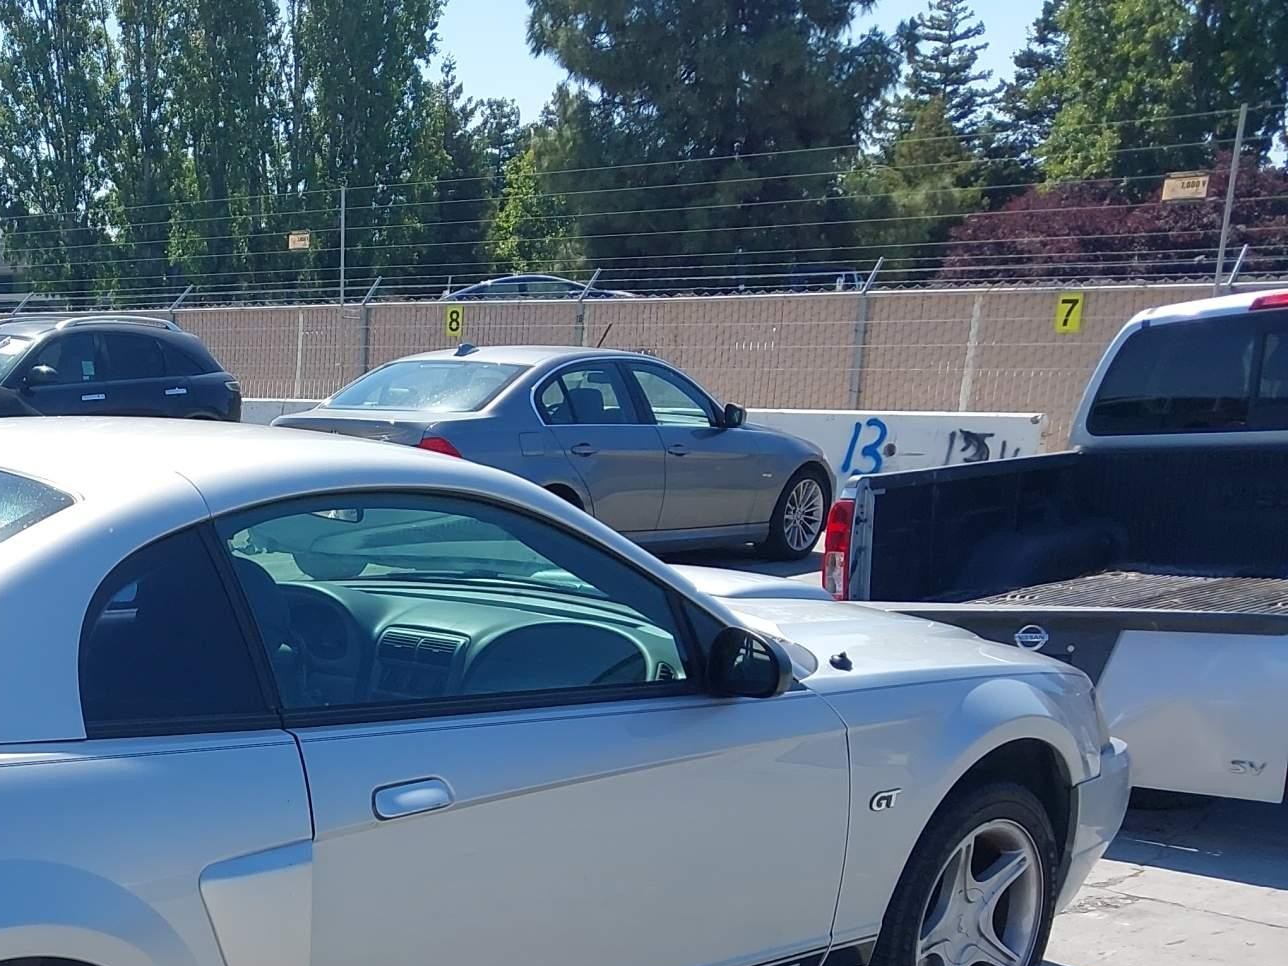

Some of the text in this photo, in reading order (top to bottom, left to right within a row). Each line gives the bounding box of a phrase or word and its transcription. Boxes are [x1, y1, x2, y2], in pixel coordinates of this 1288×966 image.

[448, 310, 460, 332] 8
[1061, 298, 1079, 327] 7
[841, 417, 888, 476] 13
[1230, 760, 1267, 776] SV
[869, 787, 902, 811] GT
